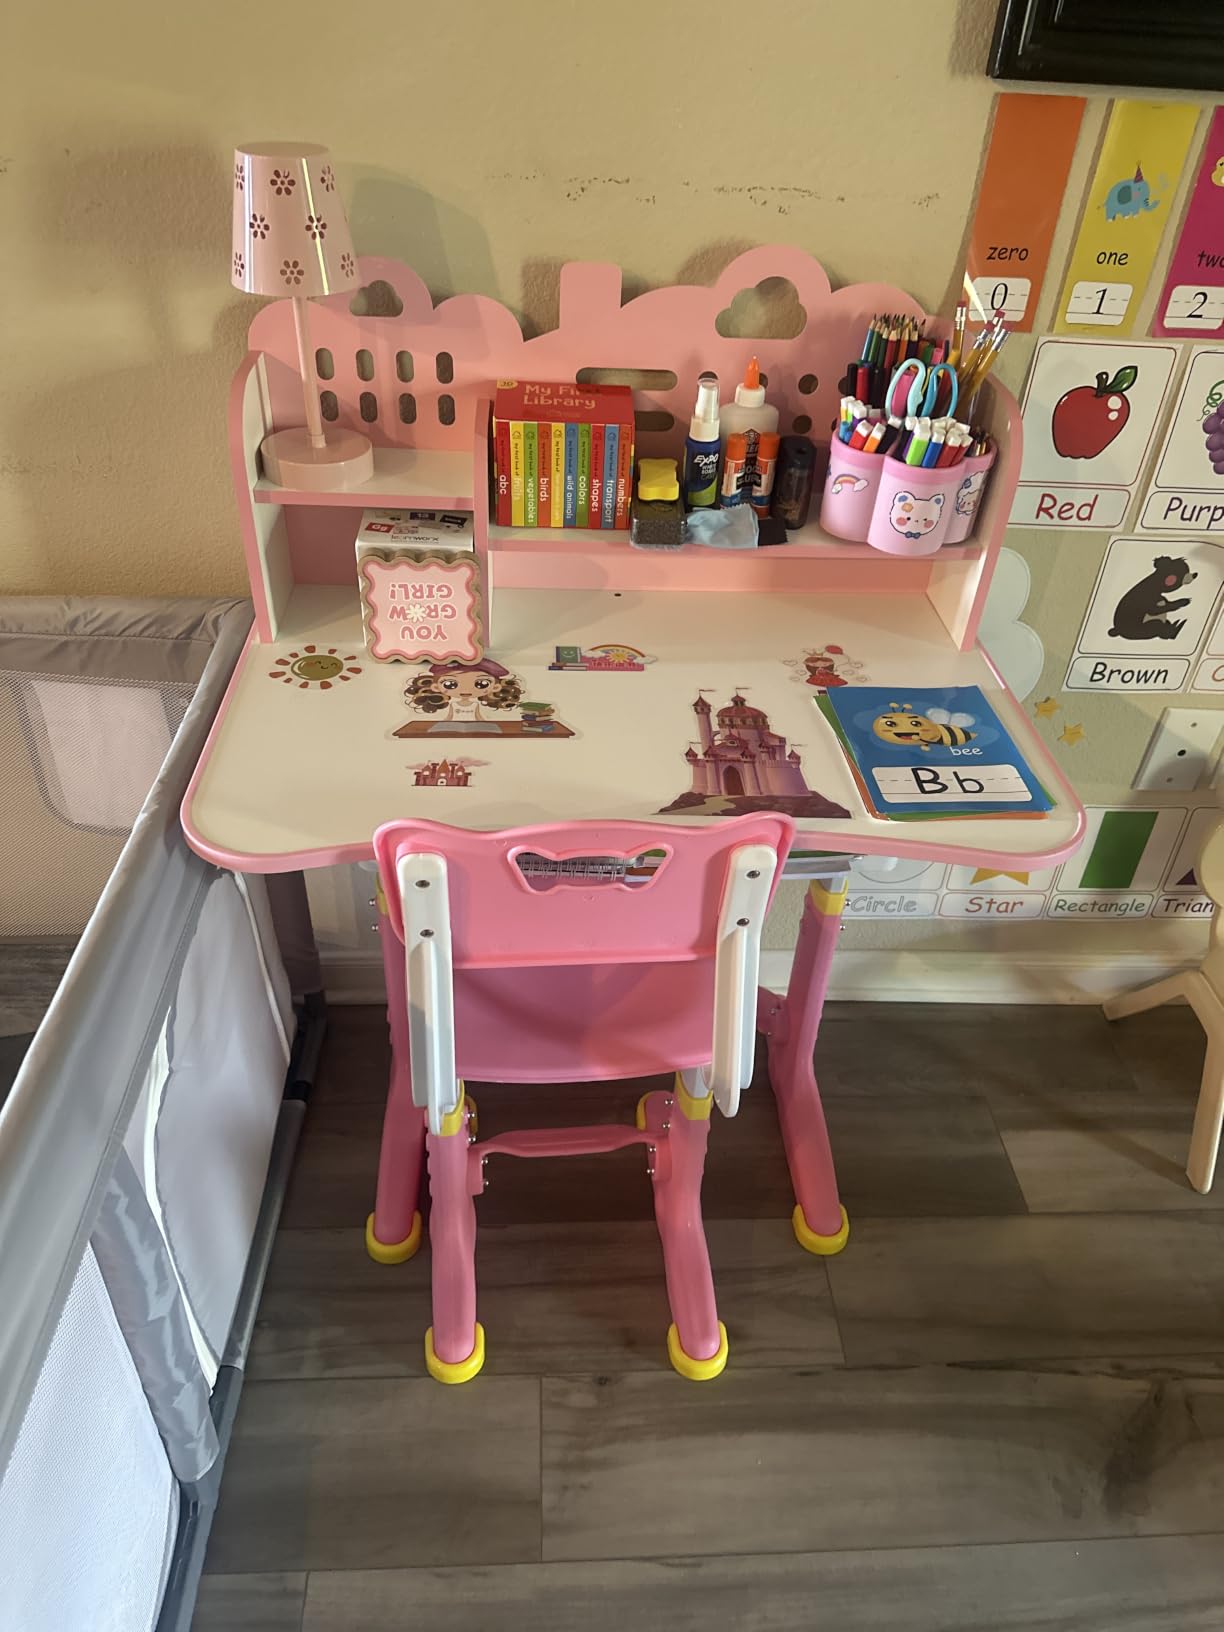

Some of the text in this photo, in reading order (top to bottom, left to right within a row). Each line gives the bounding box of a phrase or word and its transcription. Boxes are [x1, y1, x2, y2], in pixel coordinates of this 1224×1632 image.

[986, 246, 1029, 261] zero
[1096, 250, 1129, 266] one
[990, 283, 1008, 311] 0
[1091, 288, 1108, 315] 1
[1186, 291, 1208, 318] 2
[525, 384, 551, 396] My
[523, 394, 596, 409] Library
[694, 453, 719, 467] EXPO
[499, 475, 509, 495] abc
[540, 478, 549, 502] birds
[578, 476, 588, 505] colors
[527, 477, 537, 523] vegetables
[591, 479, 602, 512] shapes
[604, 480, 615, 523] transport
[616, 478, 627, 516] numbers
[1035, 493, 1099, 521] Red
[1163, 496, 1224, 530] Purp
[389, 583, 454, 600] GIRL!
[389, 603, 457, 622] GRW
[401, 625, 448, 640] YOU
[1089, 662, 1169, 684] Brown
[950, 747, 983, 756] bee
[851, 896, 917, 913] Circle
[965, 896, 1024, 913] Star
[1054, 899, 1146, 917] Rectangle
